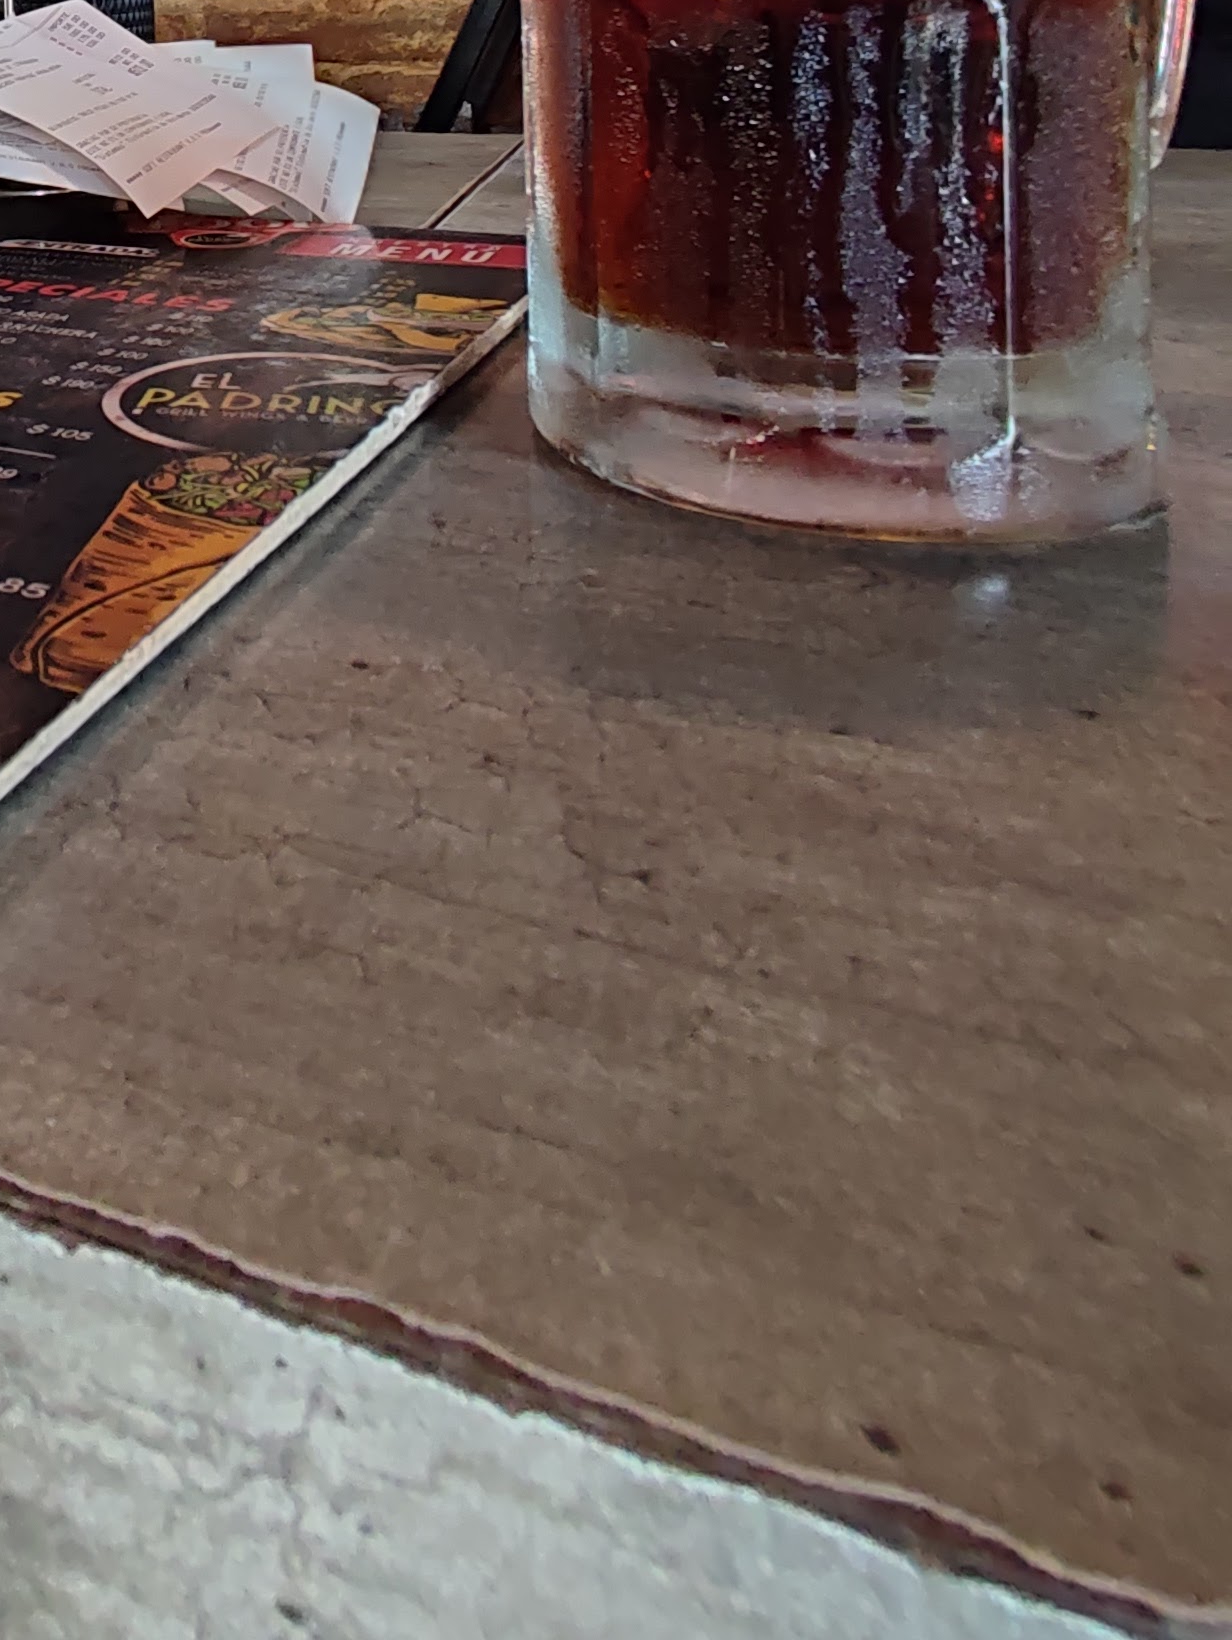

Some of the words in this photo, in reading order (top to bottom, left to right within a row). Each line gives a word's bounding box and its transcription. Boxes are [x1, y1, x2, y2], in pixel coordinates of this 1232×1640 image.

[191, 372, 241, 390] EL
[26, 423, 51, 435] $
[51, 427, 94, 442] 105
